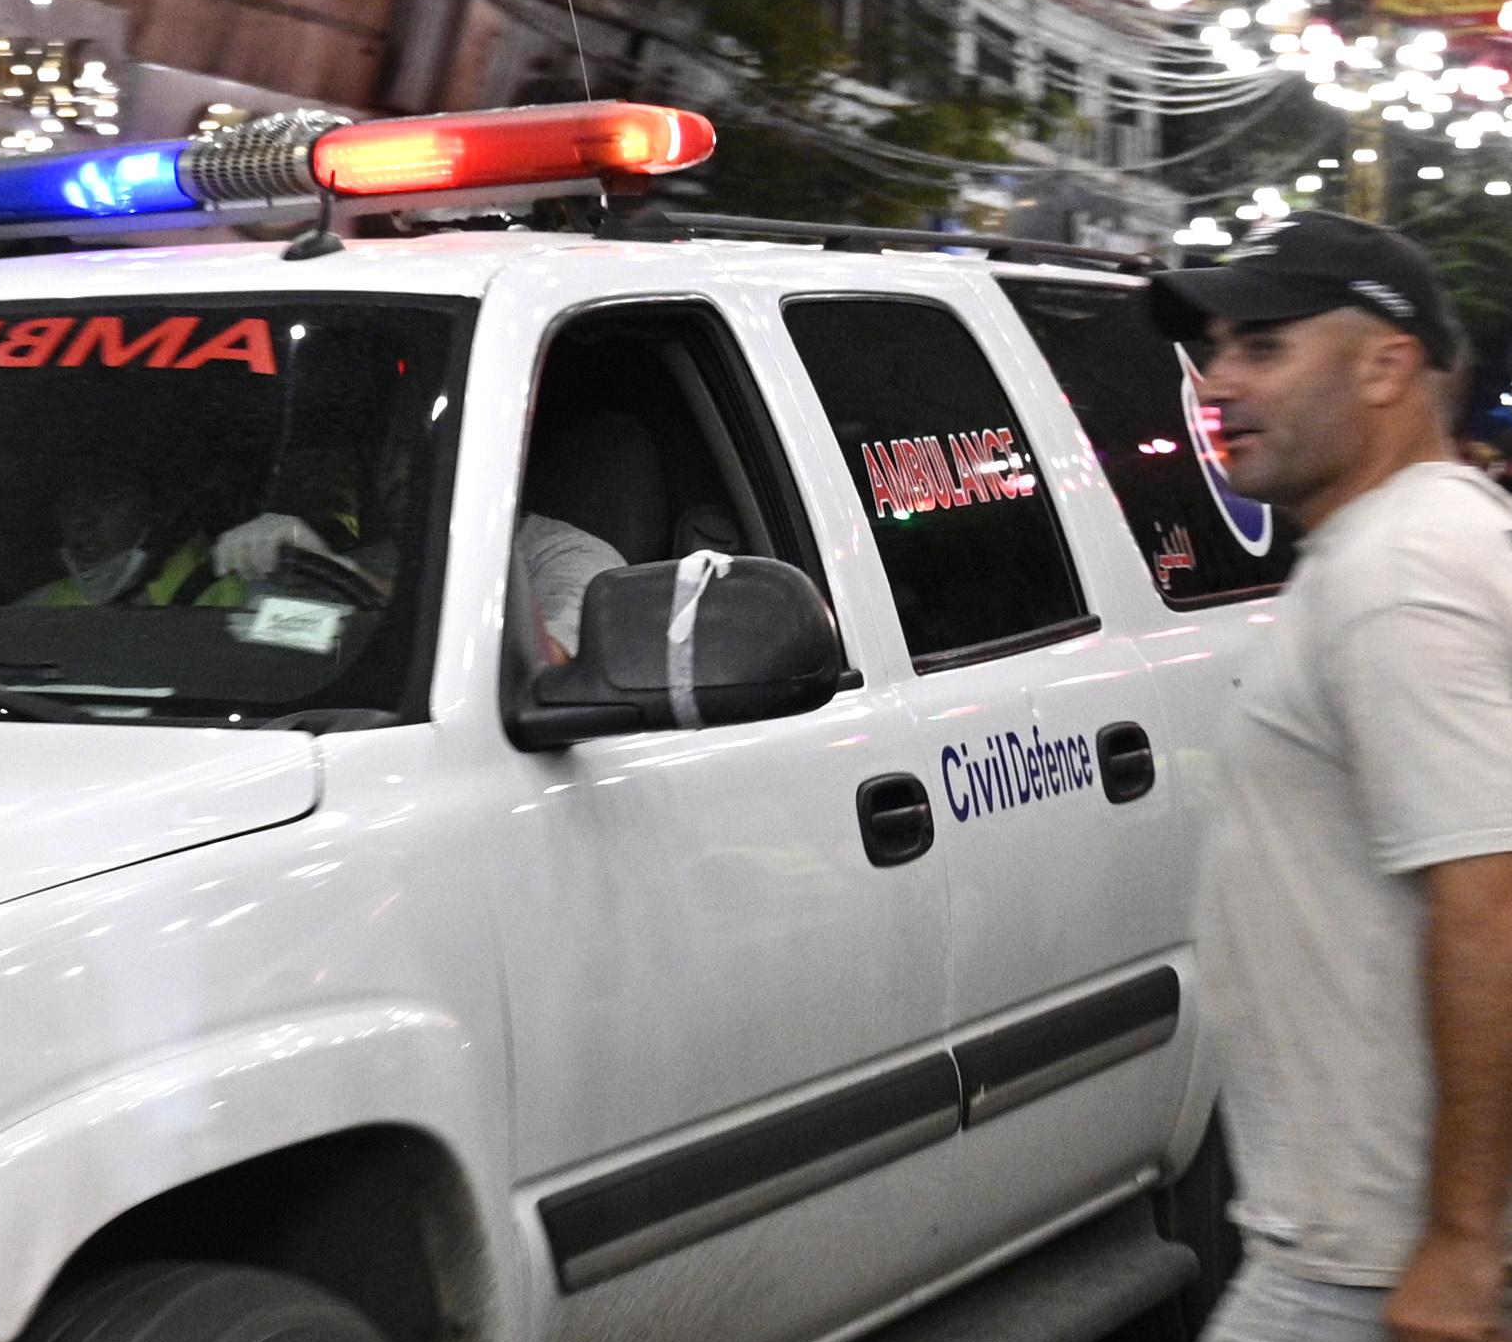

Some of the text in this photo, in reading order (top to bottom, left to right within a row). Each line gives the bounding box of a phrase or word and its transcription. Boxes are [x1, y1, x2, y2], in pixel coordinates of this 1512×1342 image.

[861, 427, 1034, 519] AMBULANCE
[941, 724, 1093, 823] Civil Defence
